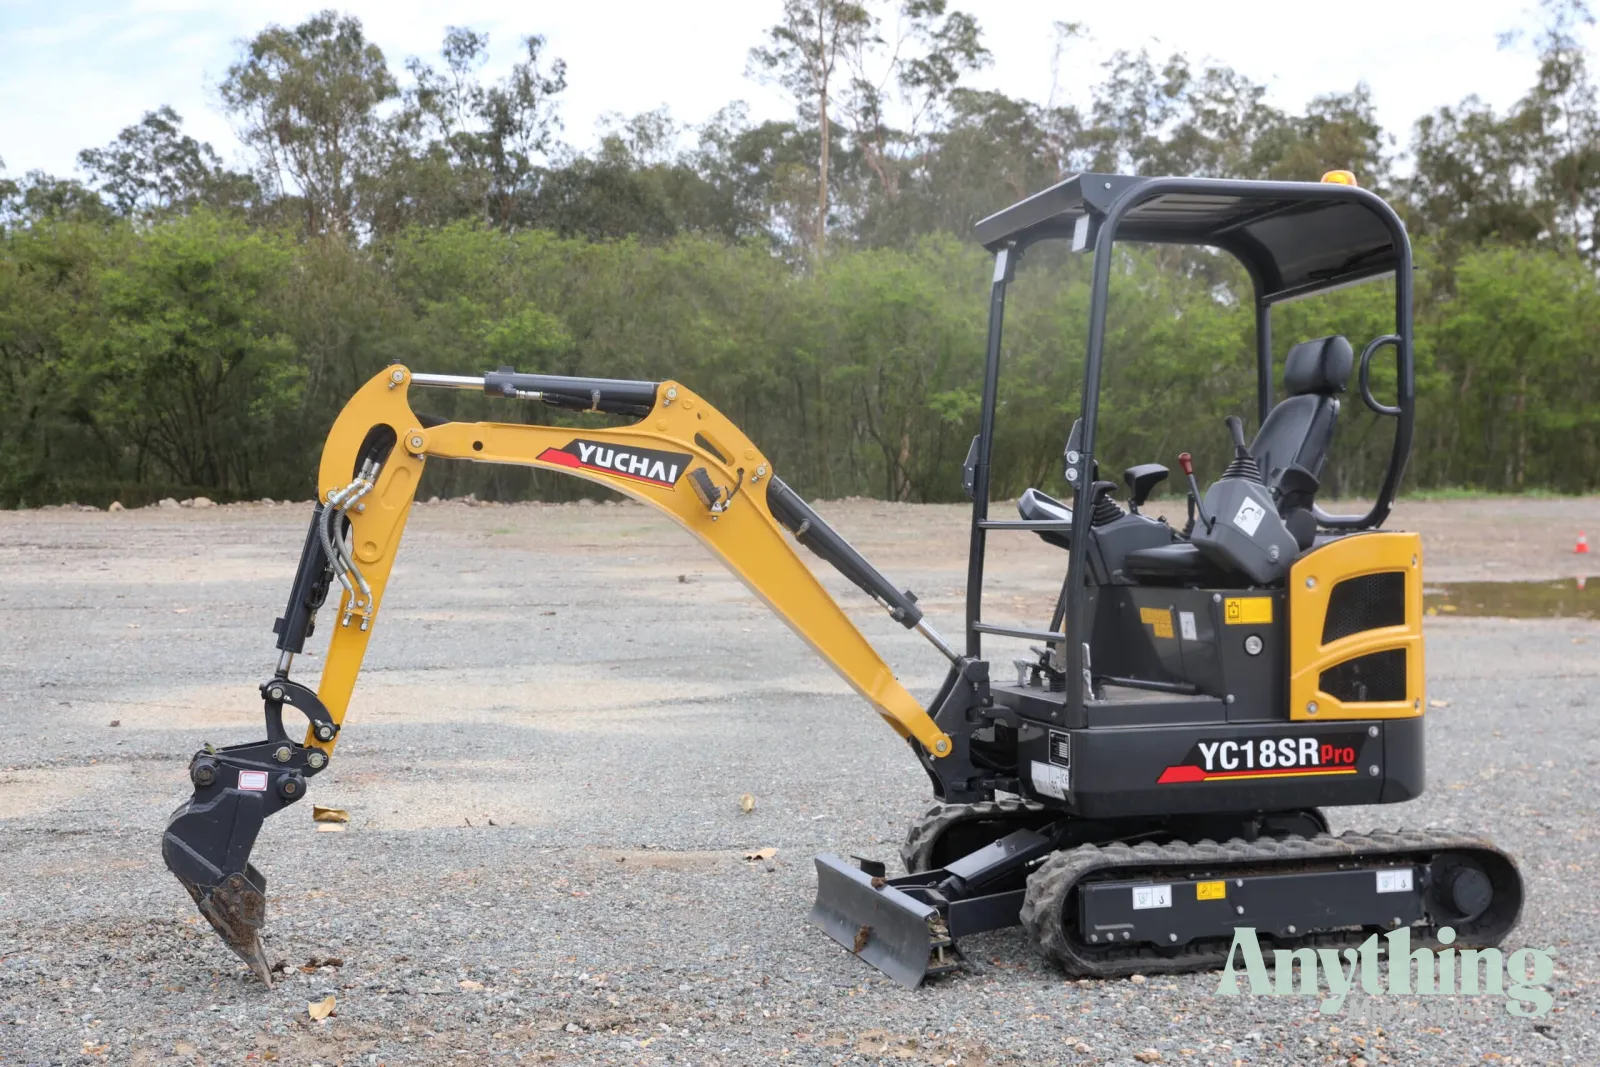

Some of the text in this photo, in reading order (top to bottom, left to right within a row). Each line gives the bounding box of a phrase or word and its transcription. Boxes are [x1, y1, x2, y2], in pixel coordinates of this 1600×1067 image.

[578, 442, 678, 483] YUCHAI
[1198, 738, 1355, 770] YC18SR Pro
